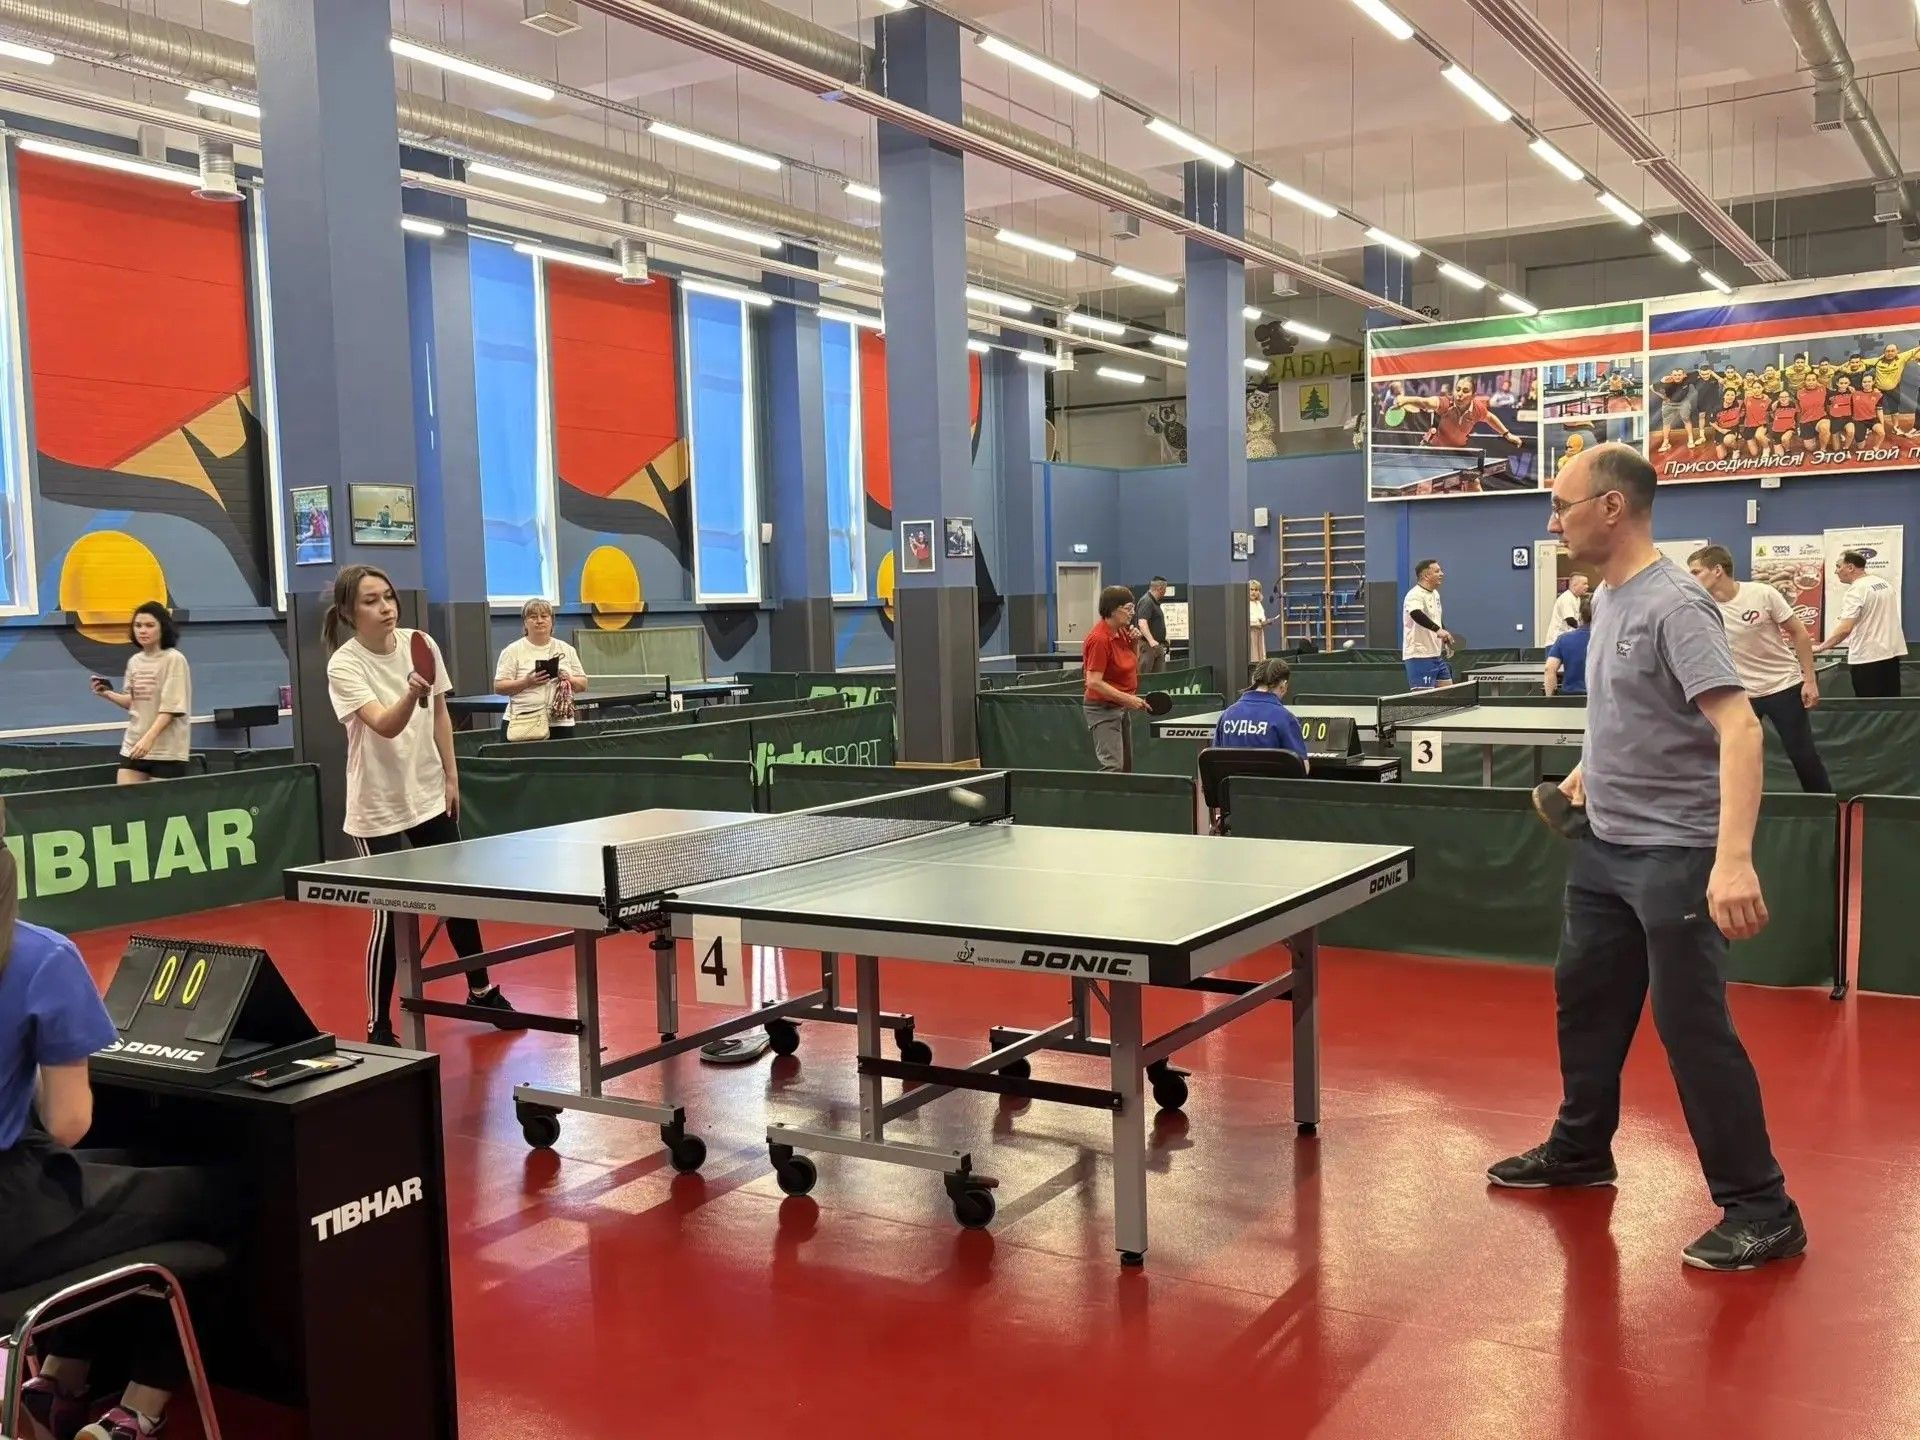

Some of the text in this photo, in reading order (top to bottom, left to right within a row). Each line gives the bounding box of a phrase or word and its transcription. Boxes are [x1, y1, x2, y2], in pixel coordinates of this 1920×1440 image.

[1664, 452, 1803, 476] Присоединяйся!
[1811, 450, 1845, 465] Это
[1856, 446, 1899, 461] твой
[674, 700, 680, 712] 9
[1166, 727, 1209, 737] DONIC
[1223, 719, 1268, 736] СУДЬЯ
[1302, 722, 1327, 740] 0 0
[1418, 740, 1433, 764] 3
[1369, 868, 1402, 894] DONIC
[307, 886, 370, 904] DONIC
[402, 900, 426, 910] CLASSIC
[619, 900, 660, 918] DONIC
[701, 935, 728, 987] 4
[1020, 950, 1132, 976] DONIC
[153, 955, 206, 1005] 0 0
[124, 1041, 206, 1062] DONIC
[311, 1176, 423, 1242] TIBHAR
